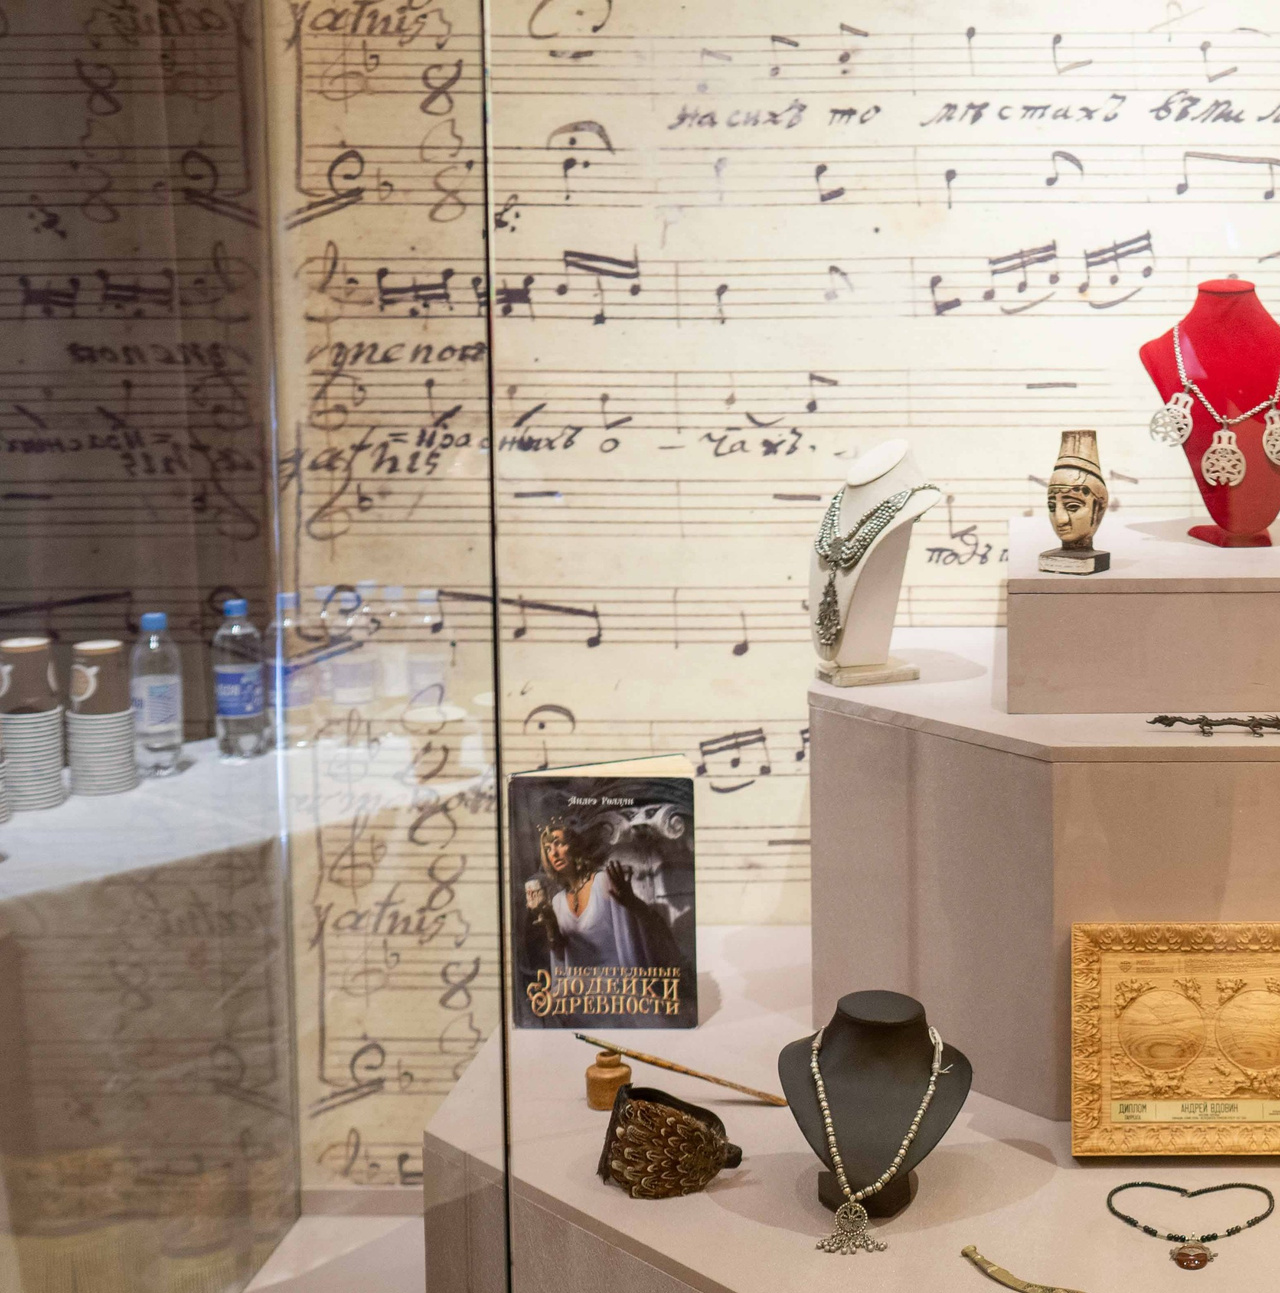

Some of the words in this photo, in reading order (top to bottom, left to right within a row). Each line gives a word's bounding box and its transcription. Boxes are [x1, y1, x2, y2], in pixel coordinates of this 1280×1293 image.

[554, 966, 681, 977] БЛИСТАТЕЛЬНЫЕ
[526, 969, 680, 1017] ЗЛОДЕЙКИ
[552, 995, 680, 1015] ДРЕВНОСТИ
[1118, 1103, 1147, 1114] ДИПЛОМ
[1181, 1102, 1208, 1114] АНДРЕЙ
[1210, 1103, 1239, 1114] ВДОВИН
